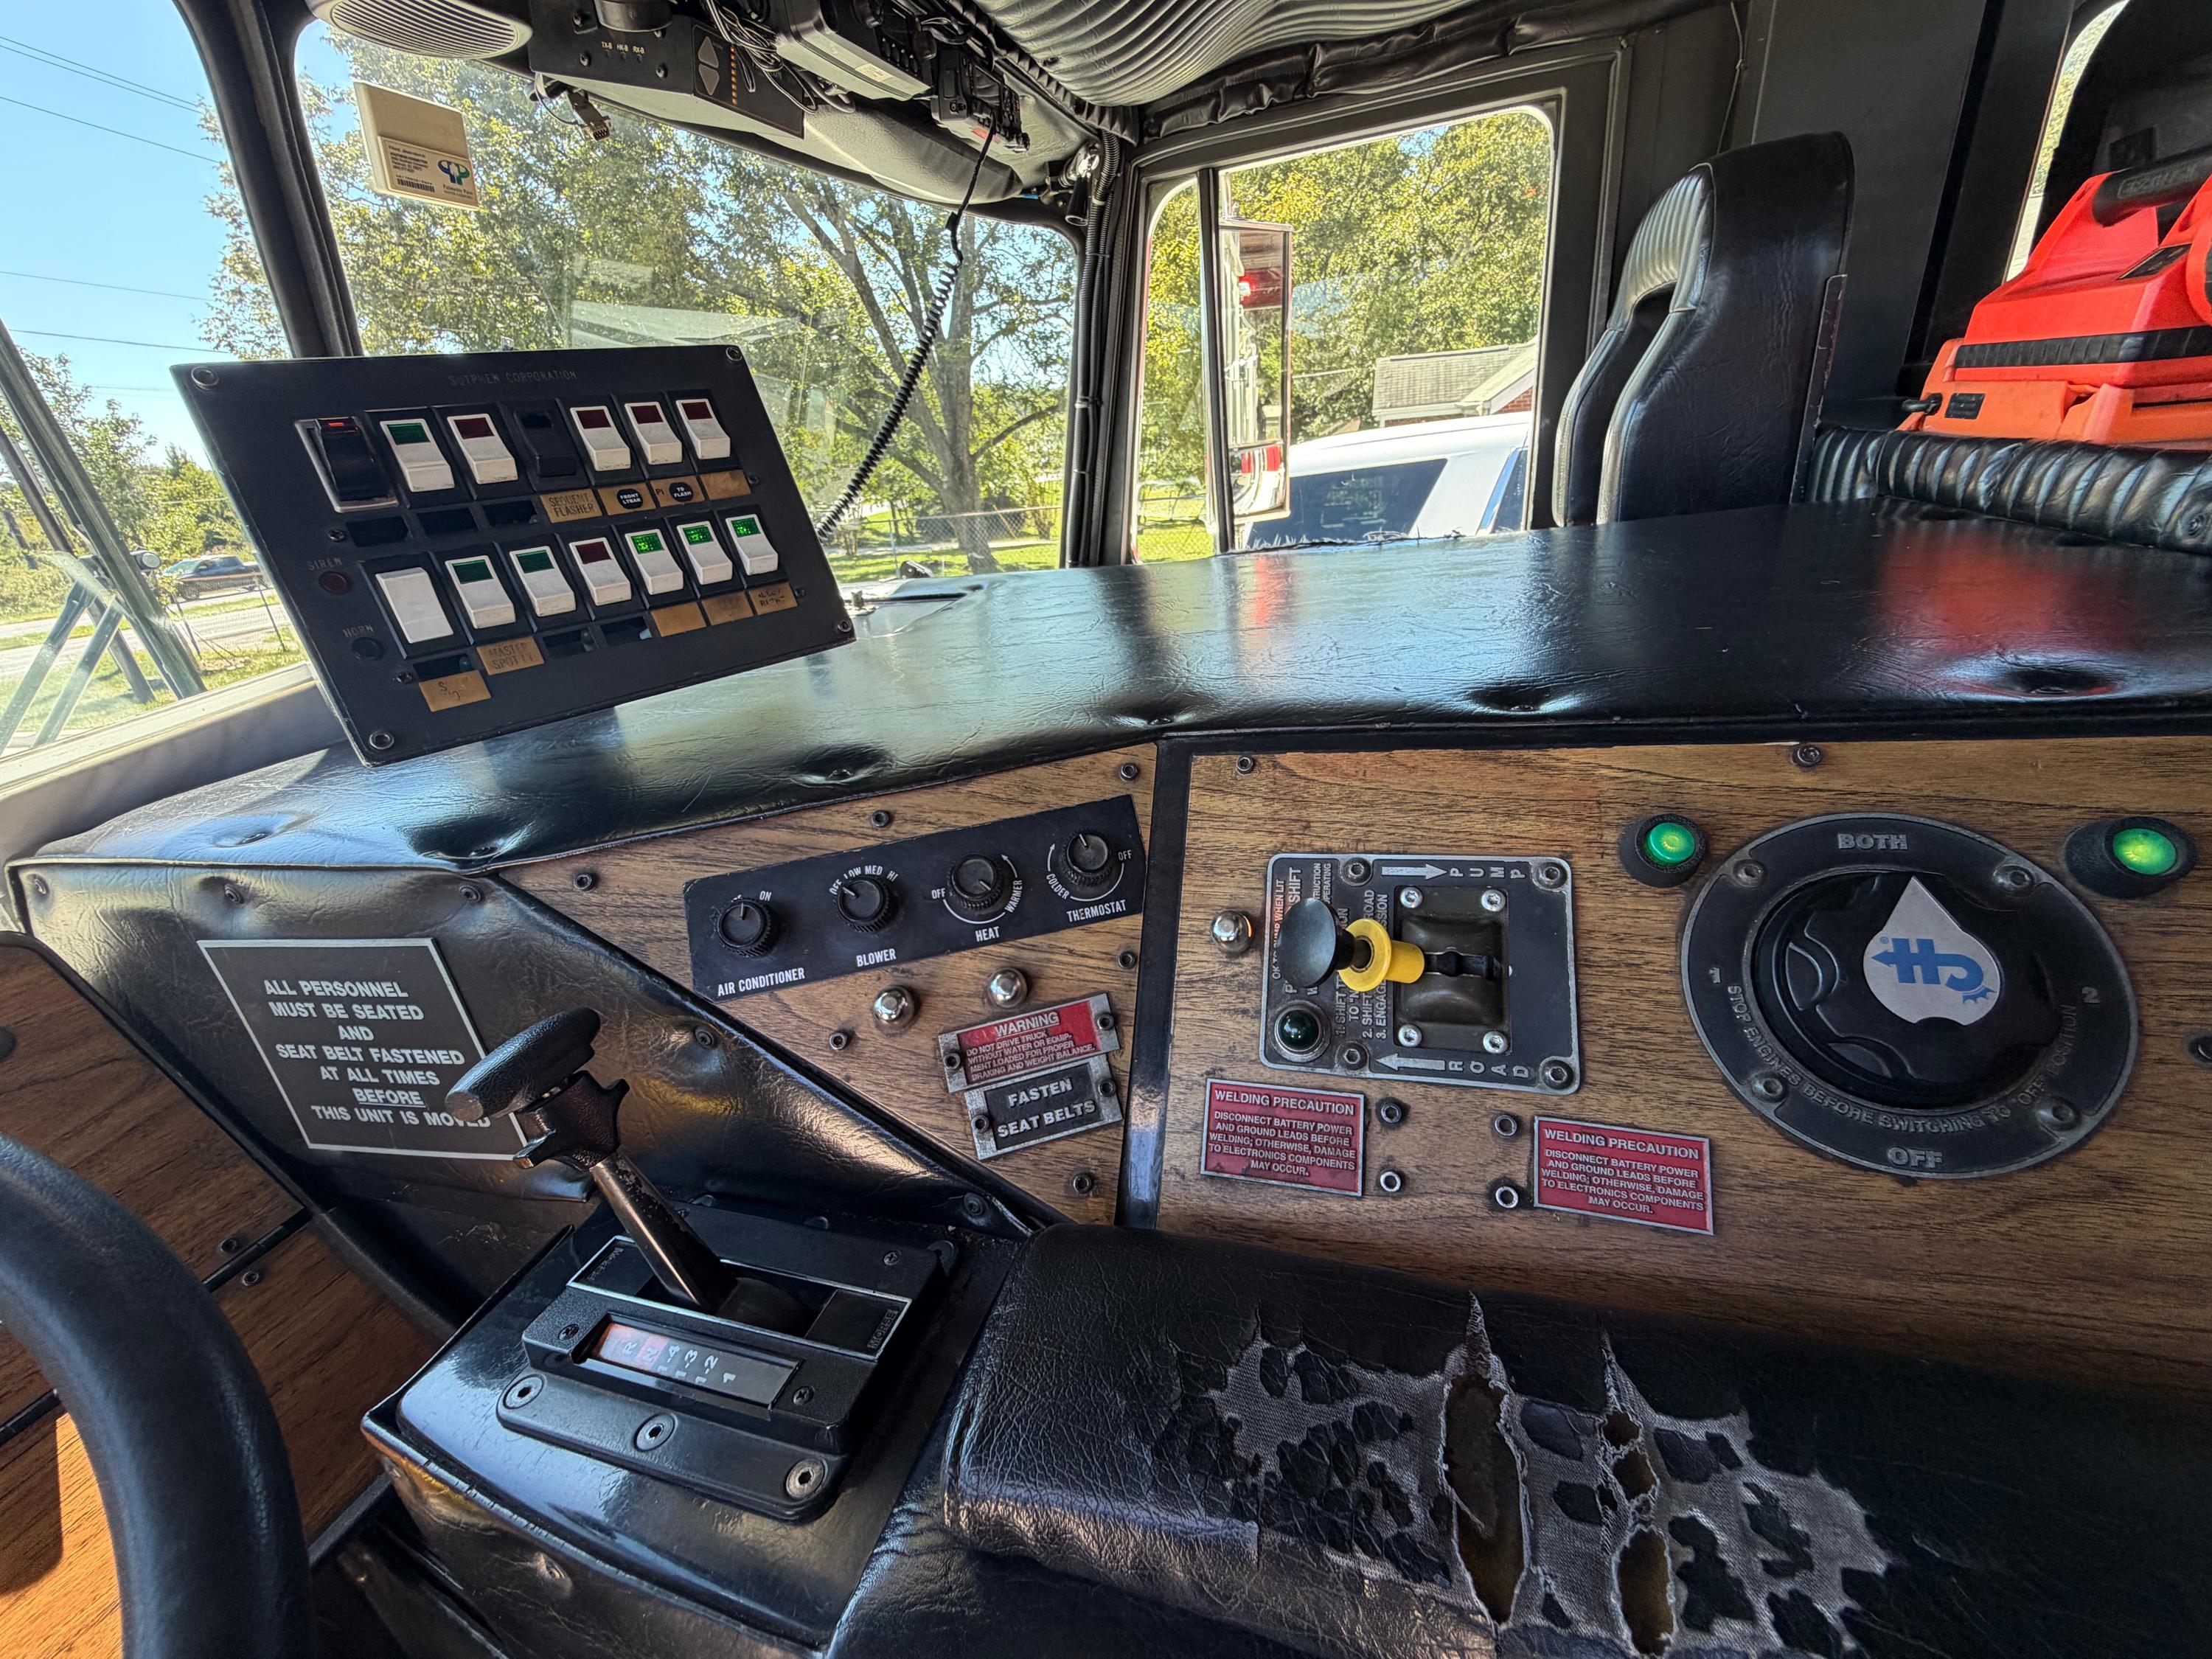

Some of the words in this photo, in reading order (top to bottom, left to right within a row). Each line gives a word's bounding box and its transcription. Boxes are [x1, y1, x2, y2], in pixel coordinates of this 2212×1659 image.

[506, 370, 578, 383] CORPORATION
[554, 503, 595, 518] FLASHER
[307, 557, 343, 571] SIREN
[342, 625, 375, 637] HORN
[493, 655, 518, 669] SPOT
[1837, 833, 1908, 850] BOTH
[1118, 849, 1132, 861] OFF
[865, 865, 883, 875] MED
[887, 871, 898, 882] HI
[1450, 866, 1526, 879] PUMP
[931, 888, 946, 900] OFF
[1046, 873, 1070, 900] COLDER
[1276, 879, 1284, 894] LIT
[1289, 867, 1302, 904] SHIFT
[759, 891, 772, 901] ON
[1004, 880, 1023, 914] WARMER
[1067, 900, 1127, 922] THERMOSTAT
[1274, 894, 1284, 922] WHEN
[975, 926, 1000, 942] HEAT
[856, 948, 897, 967] BLOWER
[717, 981, 736, 996] AIR
[738, 967, 805, 992] CONDITIONER
[1272, 965, 1281, 980] OK
[264, 980, 296, 995] ALL
[299, 981, 408, 998] PERSONNEL
[2081, 986, 2100, 1004] 2
[268, 1002, 317, 1018] MUST
[322, 1003, 349, 1019] BE
[352, 1004, 424, 1020] SEATED
[1335, 991, 1346, 1023] SHIFT
[1349, 1006, 1359, 1022] TO
[1362, 992, 1373, 1026] SHIFT
[338, 1026, 375, 1041] AND
[995, 1012, 1060, 1037] WARNING
[1362, 1029, 1373, 1038] 2.
[1376, 1029, 1386, 1039] 3.
[967, 1048, 978, 1057] DO
[979, 1043, 995, 1054] NOT
[996, 1037, 1020, 1049] DRIVE
[1021, 1031, 1048, 1043] TRUCK
[968, 1049, 1003, 1065] WITHOUT
[1004, 1043, 1033, 1057] WATER
[1034, 1039, 1046, 1048] OR
[276, 1045, 318, 1060] SEAT
[323, 1046, 364, 1062] BELT
[372, 1048, 465, 1065] FASTENED
[970, 1062, 992, 1074] MENT
[992, 1054, 1025, 1068] LOADED
[1026, 1048, 1042, 1058] FOR
[1043, 1040, 1074, 1054] PROPER
[972, 1067, 1006, 1081] BRAKING
[1007, 1062, 1024, 1072] AND
[1026, 1054, 1055, 1068] WEIGHT
[1056, 1043, 1096, 1059] BALANCE.
[1728, 984, 1752, 1023] STOP
[1744, 1026, 1803, 1087] ENGINES
[1802, 1082, 1874, 1124] BEFORE
[1879, 1113, 1986, 1134] SWITCHING
[1982, 1105, 2011, 1122] TO
[2048, 1004, 2077, 1077] POSITION
[320, 1066, 341, 1081] AT
[347, 1068, 379, 1083] ALL
[382, 1069, 440, 1085] TIMES
[1447, 1060, 1529, 1079] ROAD
[352, 1088, 425, 1106] BEFORE
[1008, 1077, 1074, 1107] FASTEN
[1215, 1090, 1270, 1106] WELDING
[1273, 1096, 1354, 1115] PRECAUTION
[311, 1107, 351, 1121] THIS
[354, 1108, 394, 1124] UNIT
[401, 1111, 419, 1125] IS
[998, 1115, 1040, 1138] SEAT
[1043, 1099, 1096, 1125] BELTS
[1214, 1111, 1272, 1126] DISCONNECT
[1274, 1118, 1315, 1131] BATTERY
[1317, 1122, 1353, 1135] POWER
[1216, 1122, 1235, 1132] AND
[1237, 1124, 1276, 1137] GROUND
[1278, 1130, 1309, 1141] LEADS
[1311, 1134, 1350, 1147] BEFORE
[1544, 1129, 1605, 1147] WELDING
[1609, 1138, 1699, 1159] PRECAUTION
[1209, 1133, 1253, 1147] WELDING;
[1255, 1138, 1312, 1155] OTHERWISE,
[1314, 1145, 1356, 1158] DAMAGE
[1208, 1143, 1221, 1152] TO
[1223, 1145, 1286, 1161] ELECTRONICS
[1288, 1153, 1355, 1170] COMPONENTS
[1545, 1149, 1609, 1165] DISCONNECT
[1611, 1158, 1657, 1172] BATTERY
[1659, 1165, 1698, 1178] POWER
[1886, 1147, 1943, 1169] OFF
[1251, 1159, 1270, 1170] MAY
[1273, 1164, 1310, 1176] OCCUR.
[1548, 1160, 1569, 1169] AND
[1571, 1163, 1615, 1176] GROUND
[1617, 1169, 1651, 1181] LEADS
[1653, 1175, 1696, 1189] BEFORE
[1541, 1168, 1590, 1183] WELDING;
[1592, 1175, 1655, 1194] OTHERWISE,
[1658, 1185, 1704, 1200] DAMAGE
[1542, 1178, 1555, 1189] TO
[1558, 1180, 1627, 1199] ELECTRONICS
[1630, 1192, 1704, 1211] COMPONENTS
[1588, 1196, 1610, 1207] MAY
[1613, 1200, 1654, 1214] OCCUR.
[866, 1309, 898, 1349] MORSE
